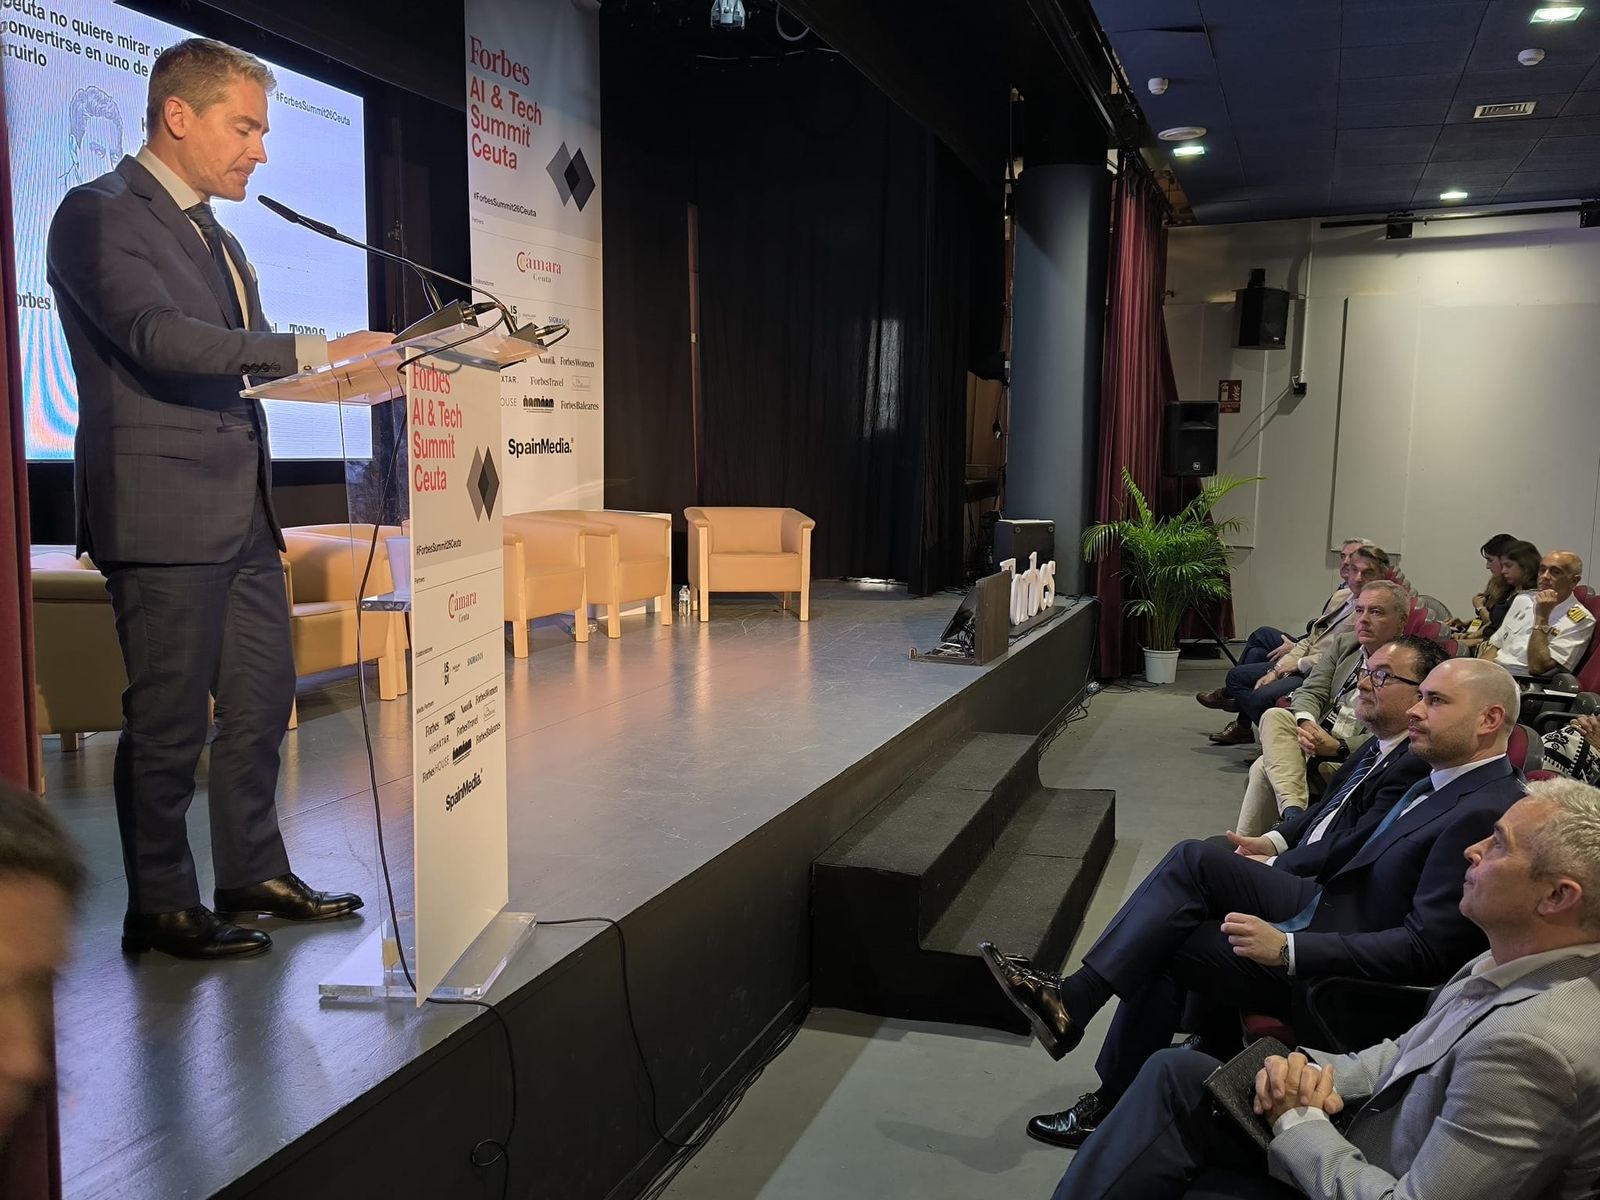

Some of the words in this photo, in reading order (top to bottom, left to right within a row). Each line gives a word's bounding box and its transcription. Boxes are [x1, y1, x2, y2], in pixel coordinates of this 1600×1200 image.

[50, 10, 67, 27] no
[72, 18, 113, 44] quiere
[118, 34, 150, 57] mirar
[85, 45, 102, 62] en
[106, 52, 129, 71] uno
[133, 60, 148, 77] de
[469, 35, 530, 86] Forbes
[470, 76, 485, 103] AI
[490, 85, 503, 110] &
[508, 91, 542, 126] Tech
[471, 105, 531, 148] Summit
[471, 134, 517, 170] Ceuta
[473, 192, 537, 217] #ForbesSummit26Ceuta
[516, 251, 561, 274] Cámara
[510, 305, 517, 314] IS
[560, 356, 595, 368] ForbesWomen
[412, 361, 451, 394] Forbes
[530, 376, 564, 387] ForbesTravel
[412, 397, 424, 426] AI
[428, 399, 436, 427] &
[438, 400, 462, 429] Tech
[413, 431, 456, 459] Summit
[414, 464, 447, 493] Ceuta
[448, 591, 477, 619] Cámara
[425, 721, 440, 738] Forbes
